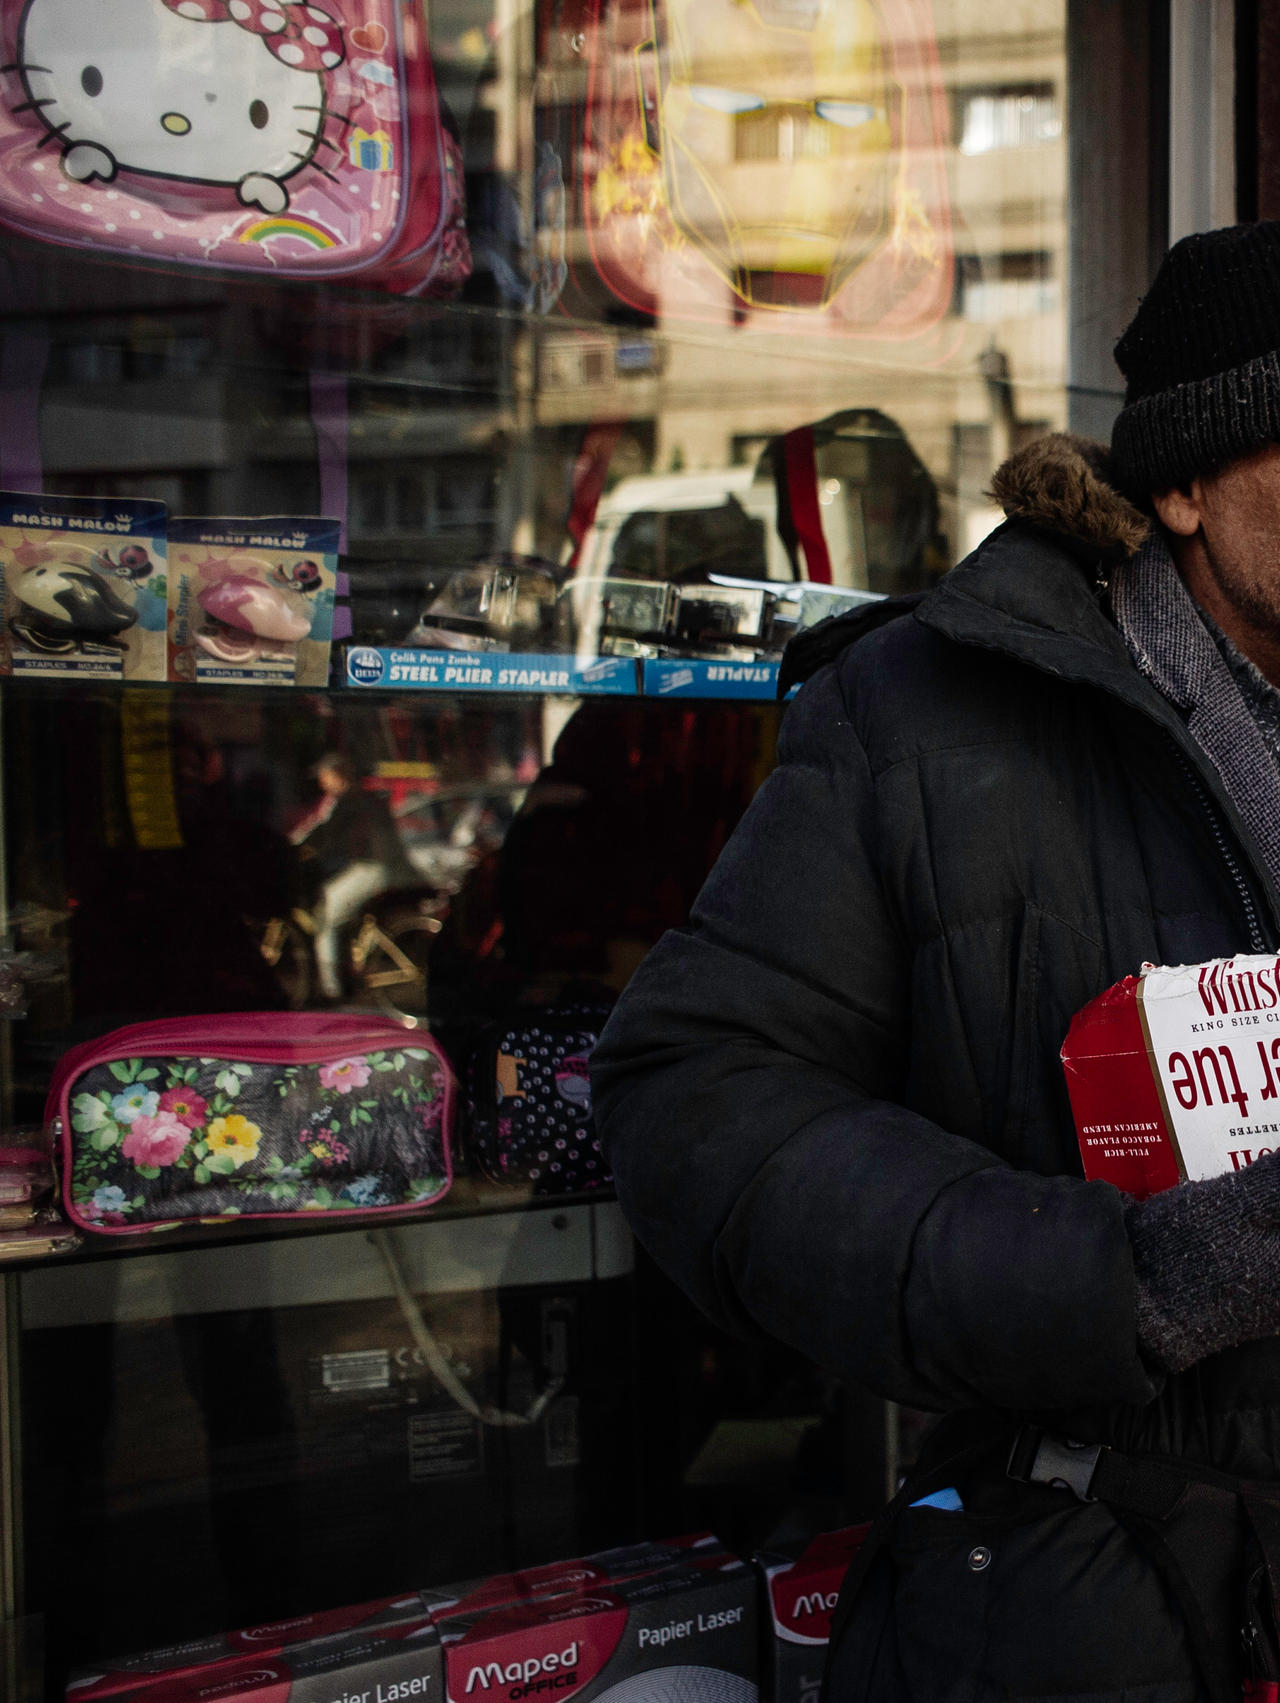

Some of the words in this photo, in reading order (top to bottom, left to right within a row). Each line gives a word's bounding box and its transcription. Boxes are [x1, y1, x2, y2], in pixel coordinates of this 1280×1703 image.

[12, 513, 63, 527] MASH
[68, 518, 132, 532] MALOW
[200, 535, 245, 544] MASH
[250, 536, 306, 548] MALOW
[389, 666, 438, 682] STEEL
[444, 668, 492, 684] PLIER
[499, 669, 569, 687] STAPLER
[706, 665, 771, 682] STAPLER
[1191, 1020, 1224, 1033] KING
[1231, 1016, 1260, 1027] SIZE
[1168, 1045, 1249, 1118] tue
[1083, 1125, 1112, 1134] BLEND
[1114, 1121, 1159, 1132] AMERICAN
[1086, 1136, 1120, 1146] FLAVOR
[1122, 1134, 1163, 1144] TOBACCO
[638, 1619, 694, 1648] Papier
[698, 1606, 744, 1632] Laser
[465, 1642, 578, 1693] Maped
[376, 1674, 431, 1703] Laser
[509, 1672, 578, 1700] OFFICE
